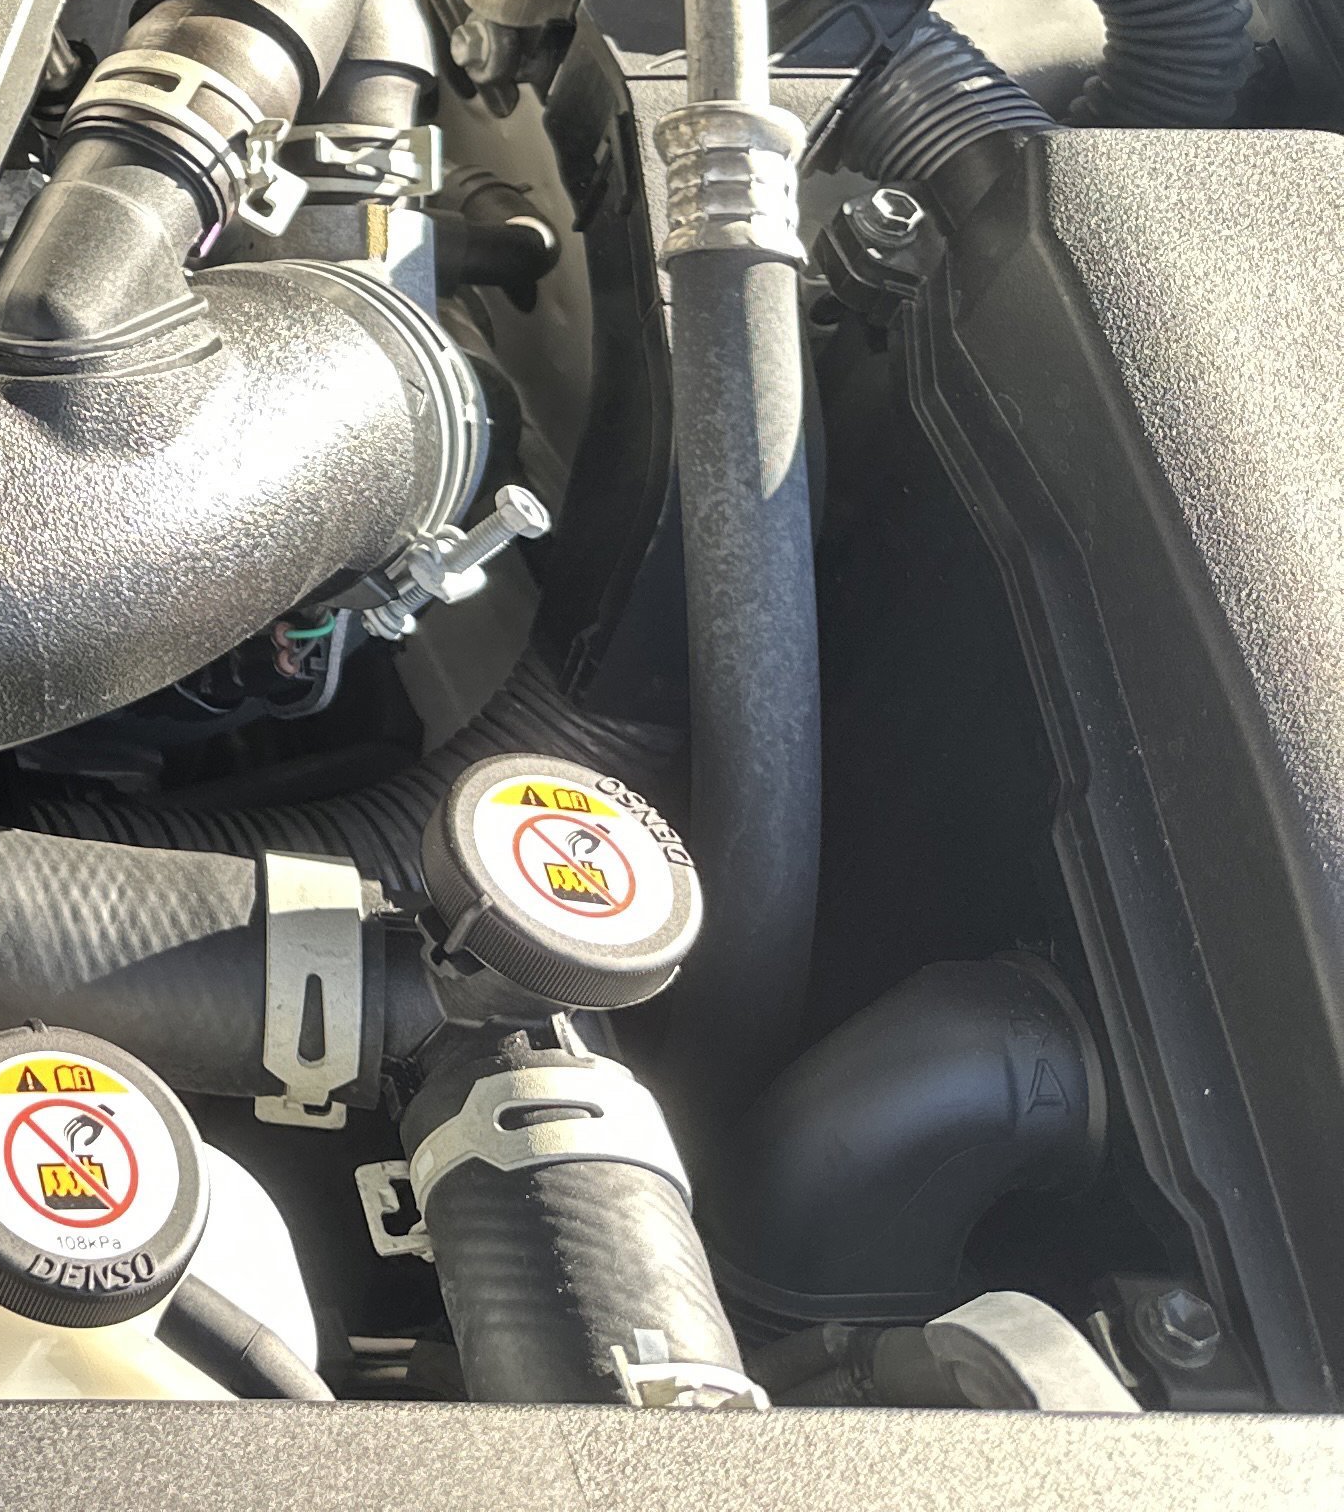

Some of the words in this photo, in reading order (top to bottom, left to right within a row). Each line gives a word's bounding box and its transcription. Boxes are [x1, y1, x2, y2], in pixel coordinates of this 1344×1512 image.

[595, 776, 696, 869] DENSO
[56, 1235, 122, 1250] 108kPa
[25, 1251, 157, 1294] DENSO
